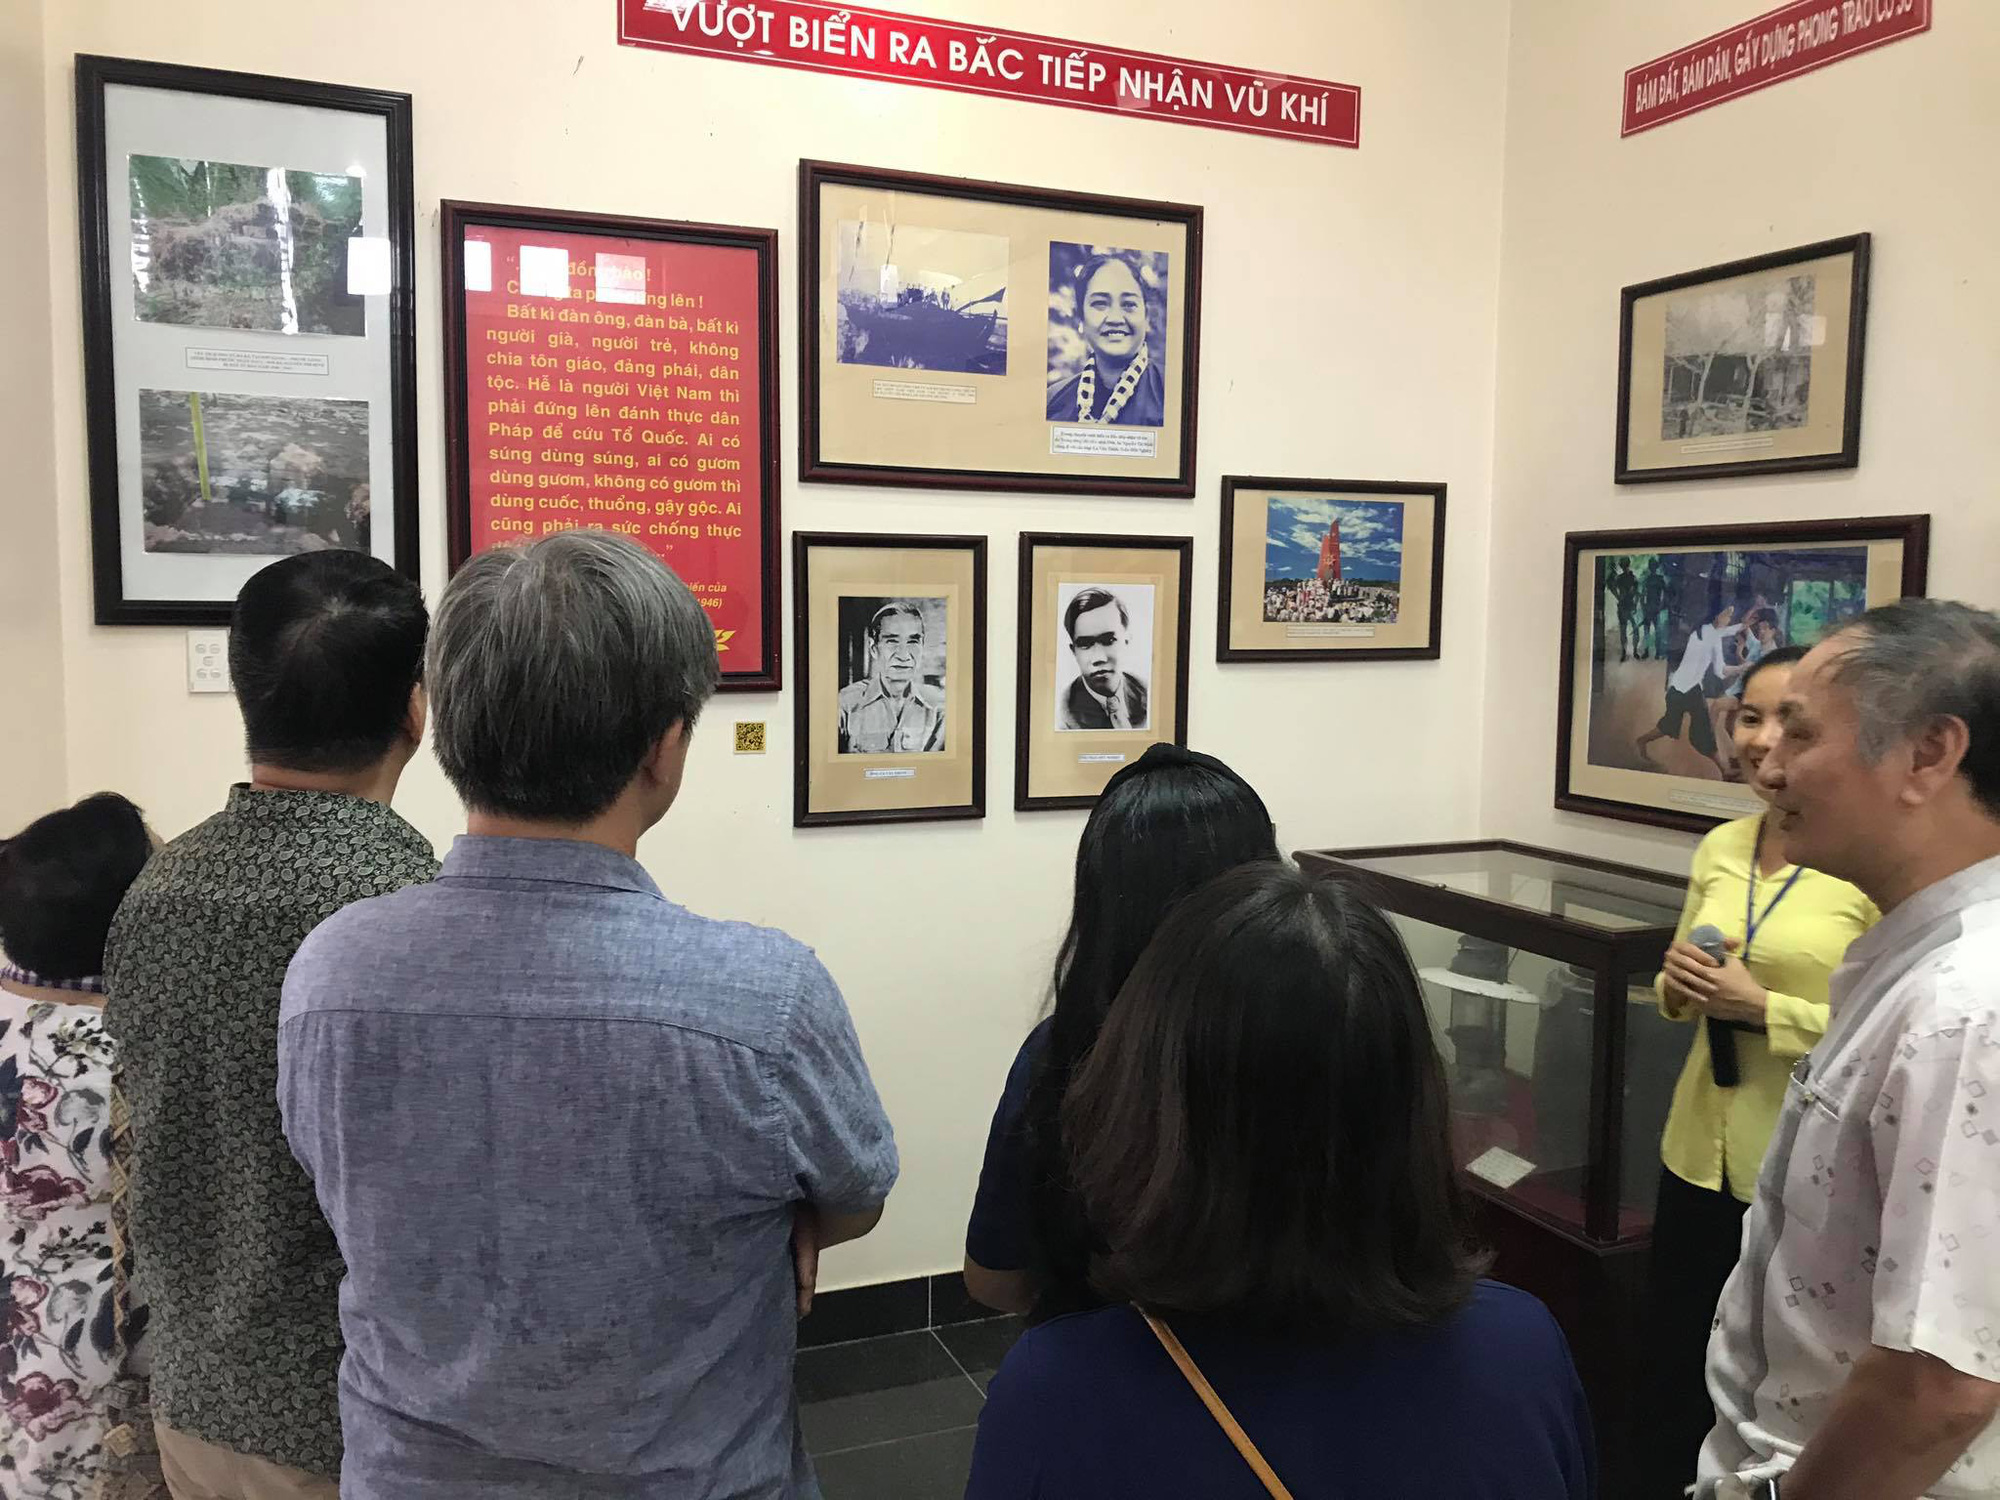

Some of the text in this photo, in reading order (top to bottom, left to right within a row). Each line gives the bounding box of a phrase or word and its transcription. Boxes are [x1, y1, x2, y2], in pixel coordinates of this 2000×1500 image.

[672, 0, 1330, 126] VƯỢT BIỂN RA BẮC TIẾP NHẬN VŨ KHÍ
[508, 305, 738, 334] Bất kì đàn ông, đàn bà, bất kì
[487, 329, 738, 360] người già, người trẻ, không
[487, 352, 738, 379] chia tôn giáo, đảng phái, dân
[487, 375, 739, 402] tộc. Hễ là người Việt Nam thì
[489, 399, 739, 425] phải đứng lên đánh thực dân
[489, 422, 740, 447] Pháp để cứu Tổ Quốc. Ai có
[490, 447, 740, 471] súng dùng súng, ai có gươm
[490, 470, 740, 493] dùng gươm, không có gươm thì
[491, 494, 741, 516] dùng cuốc, thuổng, gậy gộc. Ai
[491, 518, 533, 534] cũng
[649, 521, 699, 539] chống
[707, 524, 741, 539] thực
